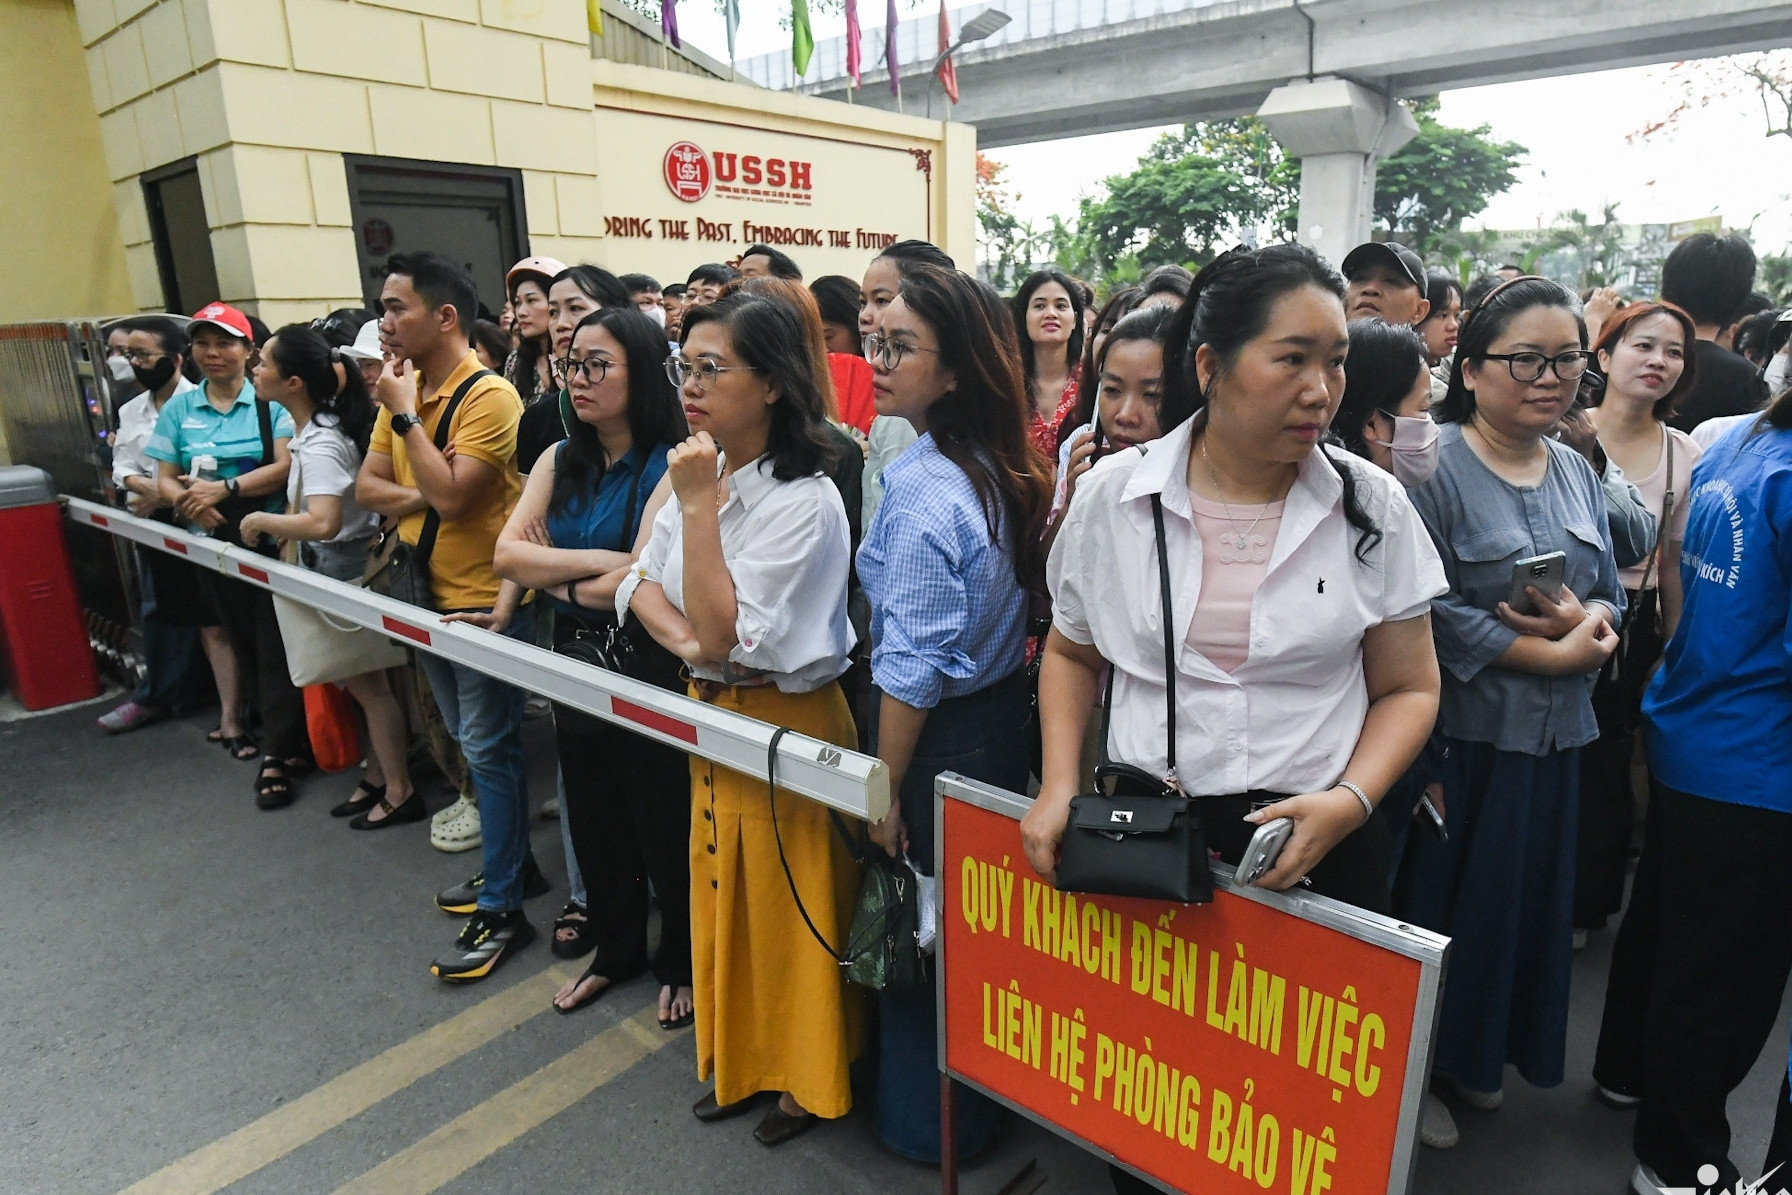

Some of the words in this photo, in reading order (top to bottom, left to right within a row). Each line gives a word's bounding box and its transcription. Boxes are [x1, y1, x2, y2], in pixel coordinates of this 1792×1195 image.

[713, 151, 812, 190] USSH
[659, 219, 690, 241] THE
[743, 220, 823, 247] EMBRACING
[828, 229, 851, 248] THE
[1729, 510, 1743, 529] VÀ
[1732, 528, 1744, 562] NHÂN
[1725, 565, 1740, 589] VĂN
[962, 855, 1014, 939] QUÝ
[1131, 910, 1198, 1017] ĐẾN
[1206, 941, 1287, 1056] LÀM
[1296, 984, 1386, 1103] VIỆC
[983, 979, 1042, 1070] LIÊN
[1050, 1007, 1087, 1105] HỆ
[1094, 1033, 1201, 1150] PHÒNG
[1207, 1077, 1281, 1189] BẢO
